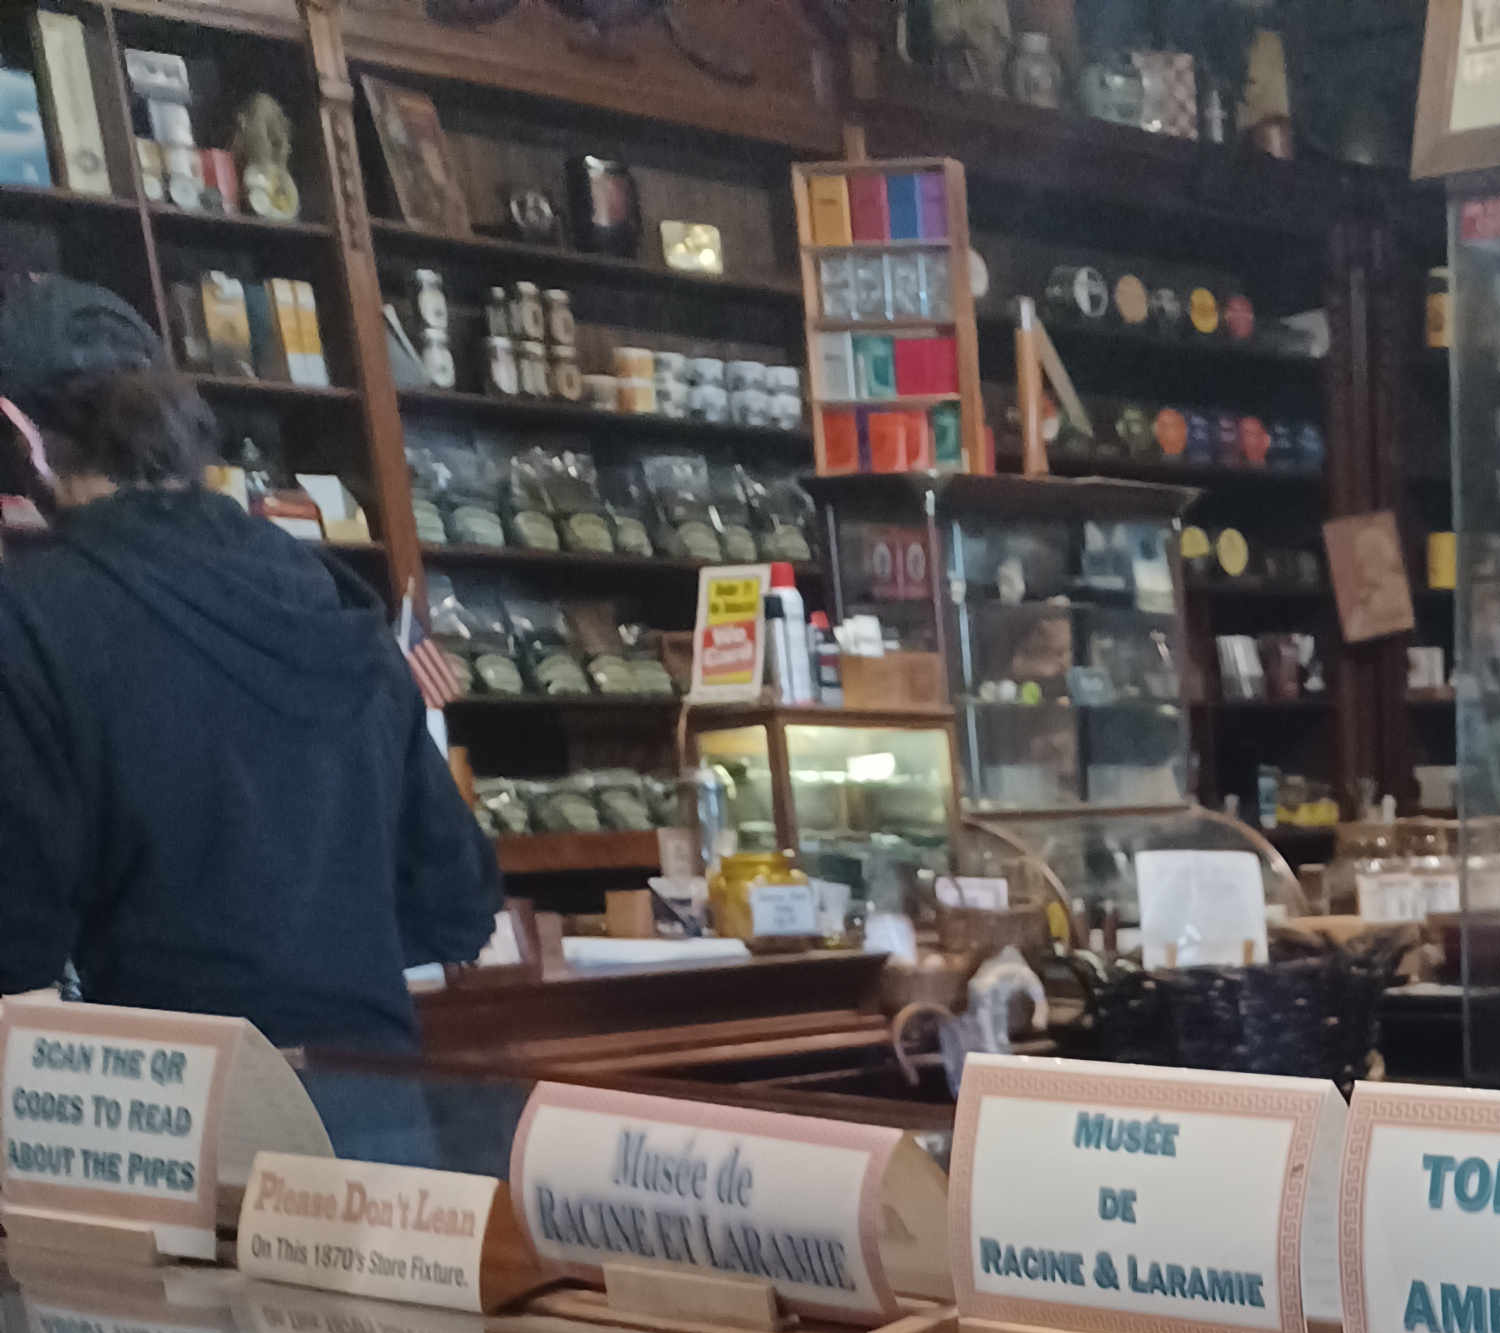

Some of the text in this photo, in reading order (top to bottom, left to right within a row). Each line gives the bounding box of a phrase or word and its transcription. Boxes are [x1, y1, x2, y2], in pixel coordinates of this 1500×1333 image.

[32, 1037, 187, 1086] SCAN THE QR
[12, 1086, 193, 1138] CODES TO READ
[1073, 1110, 1180, 1157] MUSÉE
[7, 1138, 195, 1192] ABOUT THE PIPES
[715, 1144, 754, 1209] de
[255, 1170, 475, 1238] Please Don't Lean
[1098, 1187, 1137, 1224] DE
[251, 1233, 469, 1287] On This 1870's Store Fixture.
[536, 1184, 857, 1293] RACINE ET LARAMIE
[979, 1236, 1266, 1309] RACINE & LARAMIE
